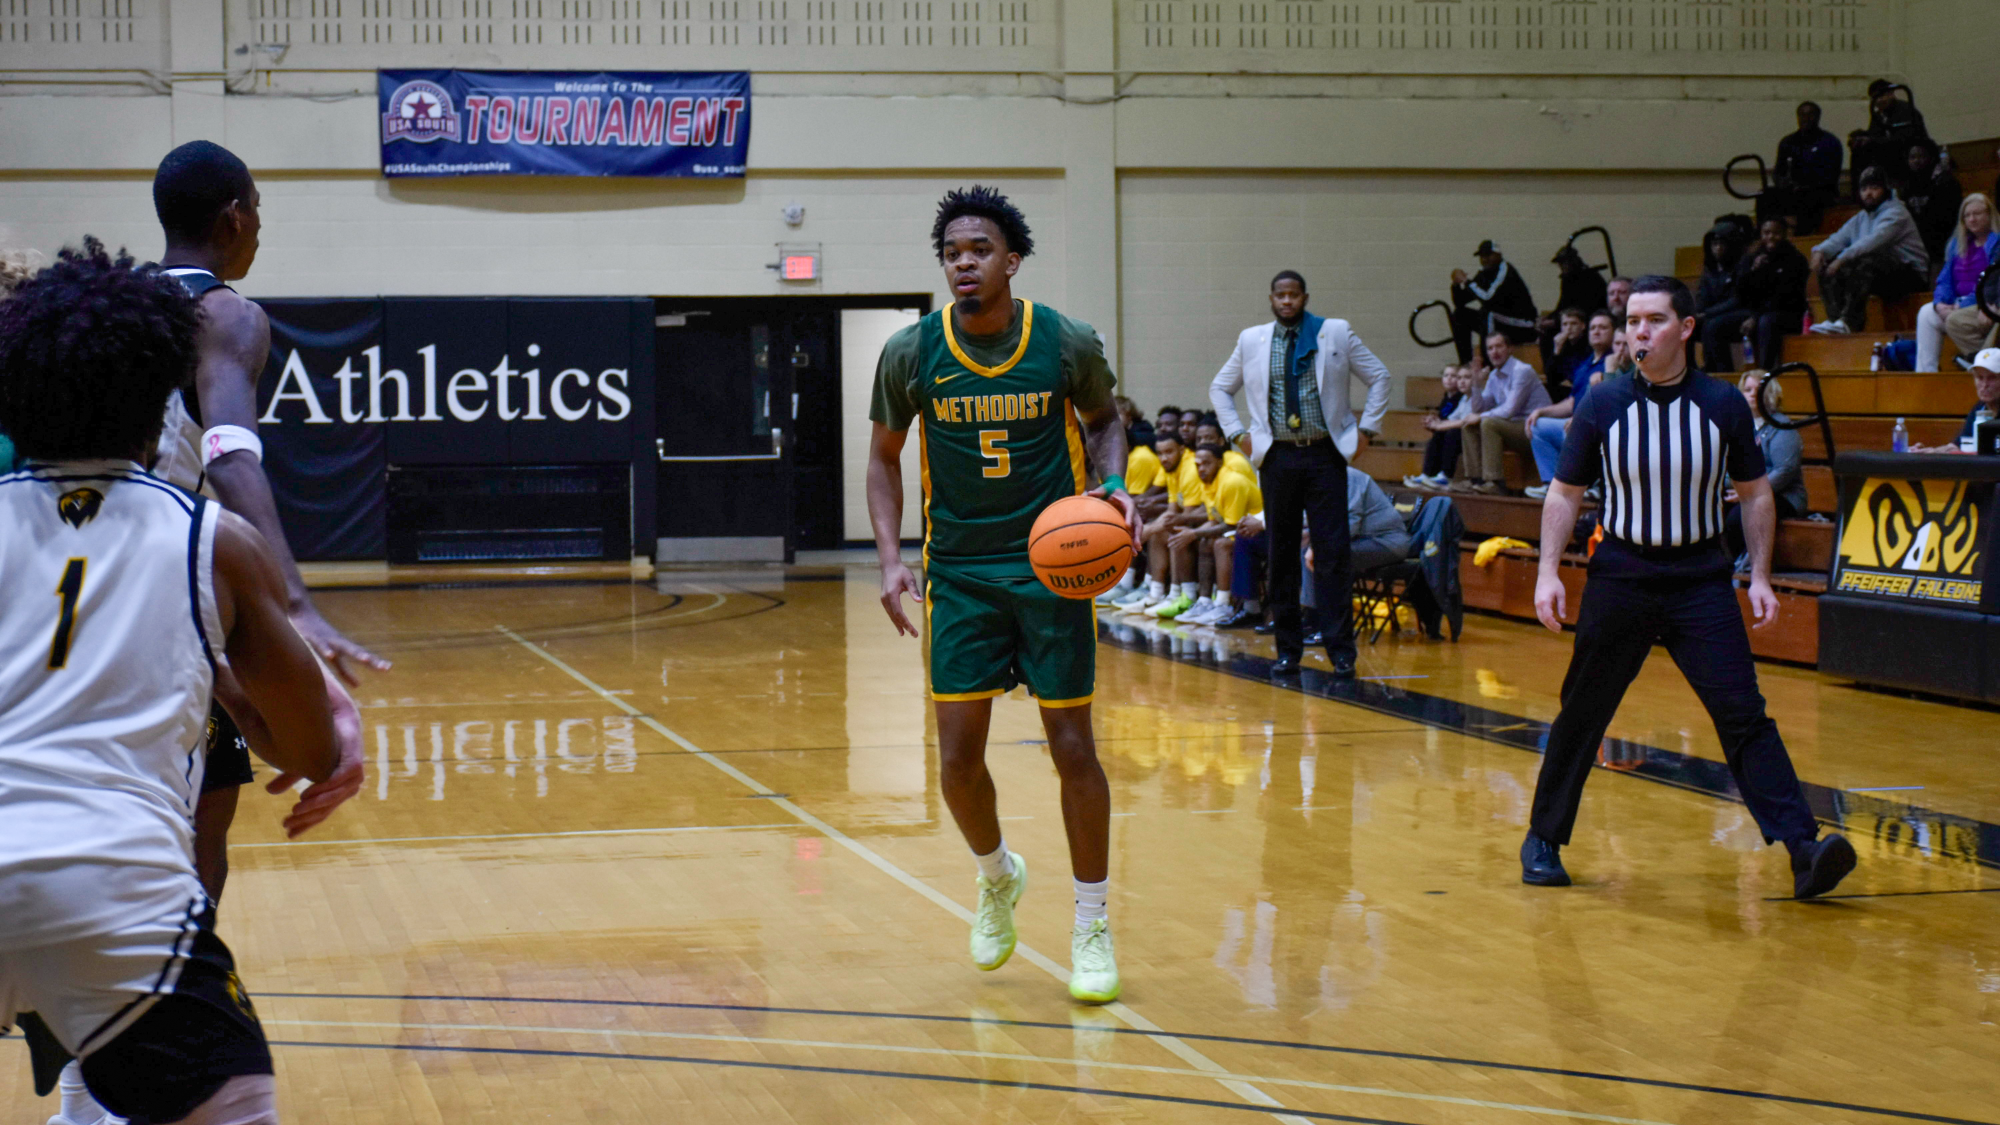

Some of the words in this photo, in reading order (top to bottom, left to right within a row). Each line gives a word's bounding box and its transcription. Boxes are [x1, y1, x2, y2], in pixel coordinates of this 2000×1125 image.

[554, 82, 609, 92] Welcome
[613, 82, 628, 92] To
[631, 82, 653, 93] The
[389, 119, 412, 133] USA
[417, 119, 455, 133] SOUTH
[465, 96, 745, 146] TOURNAMENT
[384, 162, 511, 173] #USASouthChampionships
[258, 343, 632, 424] Athletics
[932, 392, 1052, 423] METHODIST
[979, 429, 1011, 478] 5
[1048, 565, 1117, 589] Wilson
[1838, 570, 1915, 597] PFEIFFER
[48, 557, 87, 670] 1
